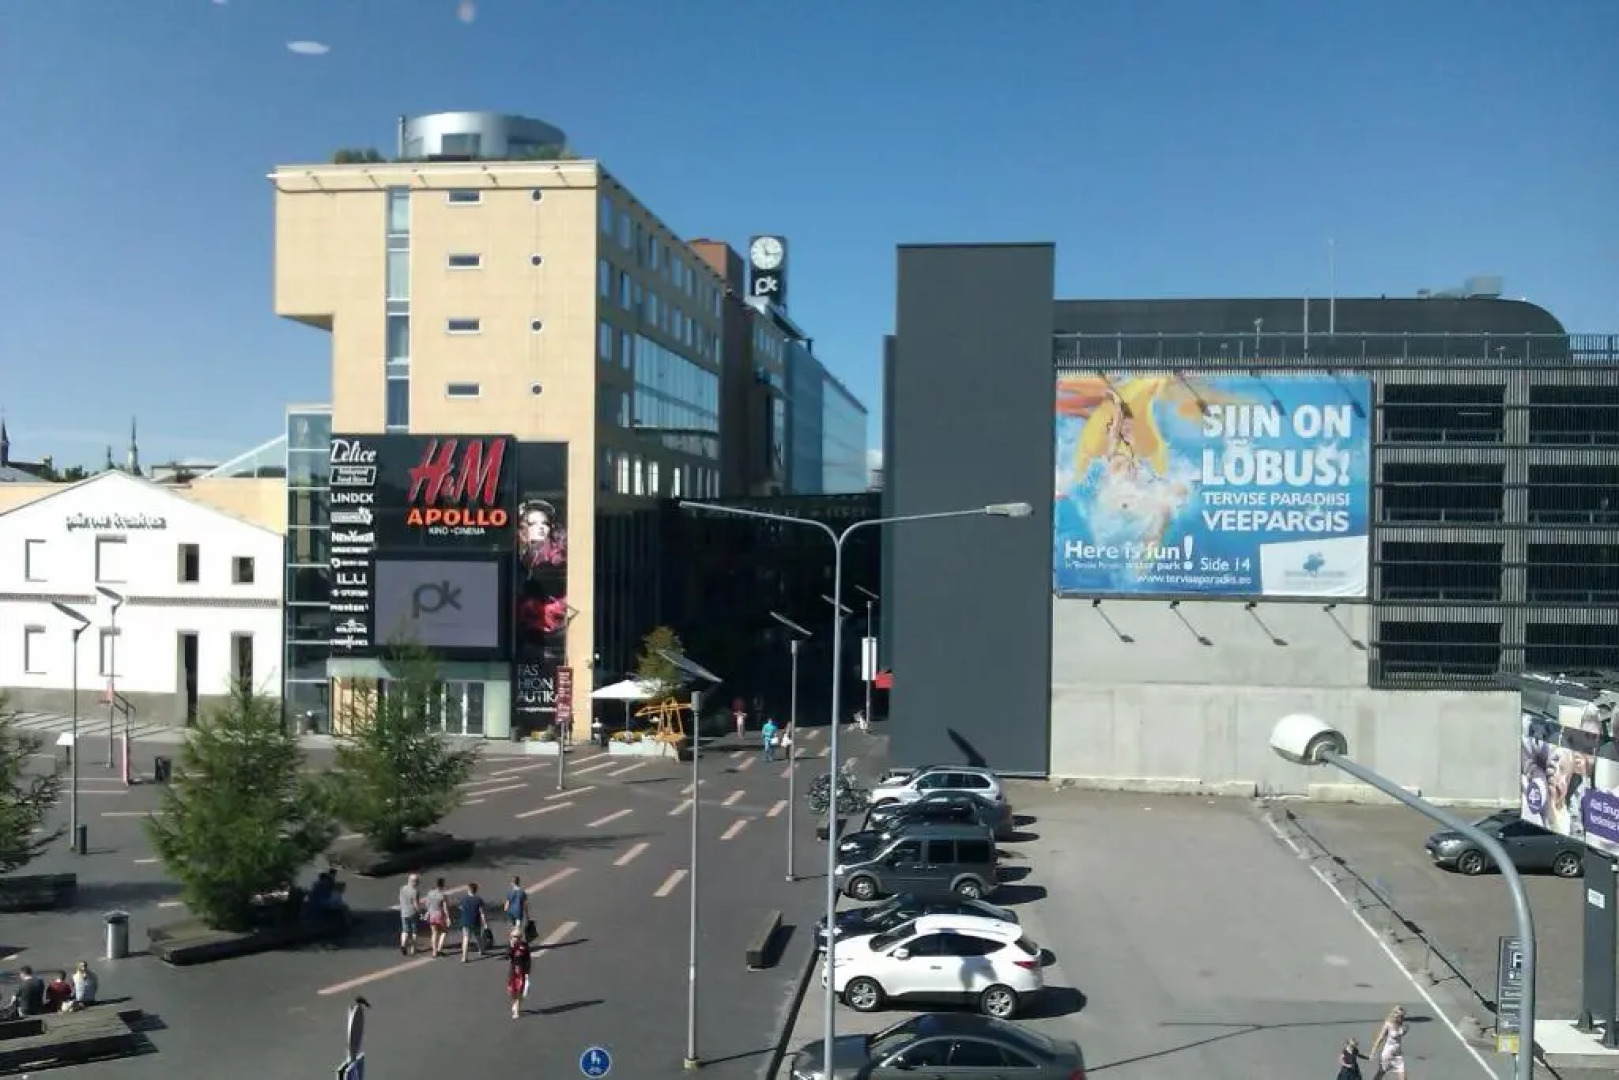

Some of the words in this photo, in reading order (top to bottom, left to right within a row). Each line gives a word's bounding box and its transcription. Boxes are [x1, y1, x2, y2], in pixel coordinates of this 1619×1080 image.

[1202, 404, 1281, 438] SIIN
[1293, 404, 1352, 438] ON
[1202, 438, 1351, 486] LÕBUS!
[407, 438, 506, 506] H&M
[331, 492, 374, 504] LINDEX
[1202, 491, 1267, 506] TERVISE
[1270, 491, 1350, 507] PARADIISI
[407, 508, 507, 526] APOLLO
[1202, 510, 1350, 532] VEEPARGIS
[1064, 540, 1120, 559] Here
[1156, 560, 1181, 572] park
[1200, 558, 1230, 571] Side
[1235, 557, 1251, 572] 14
[412, 580, 462, 618] pk
[518, 663, 538, 675] FAS
